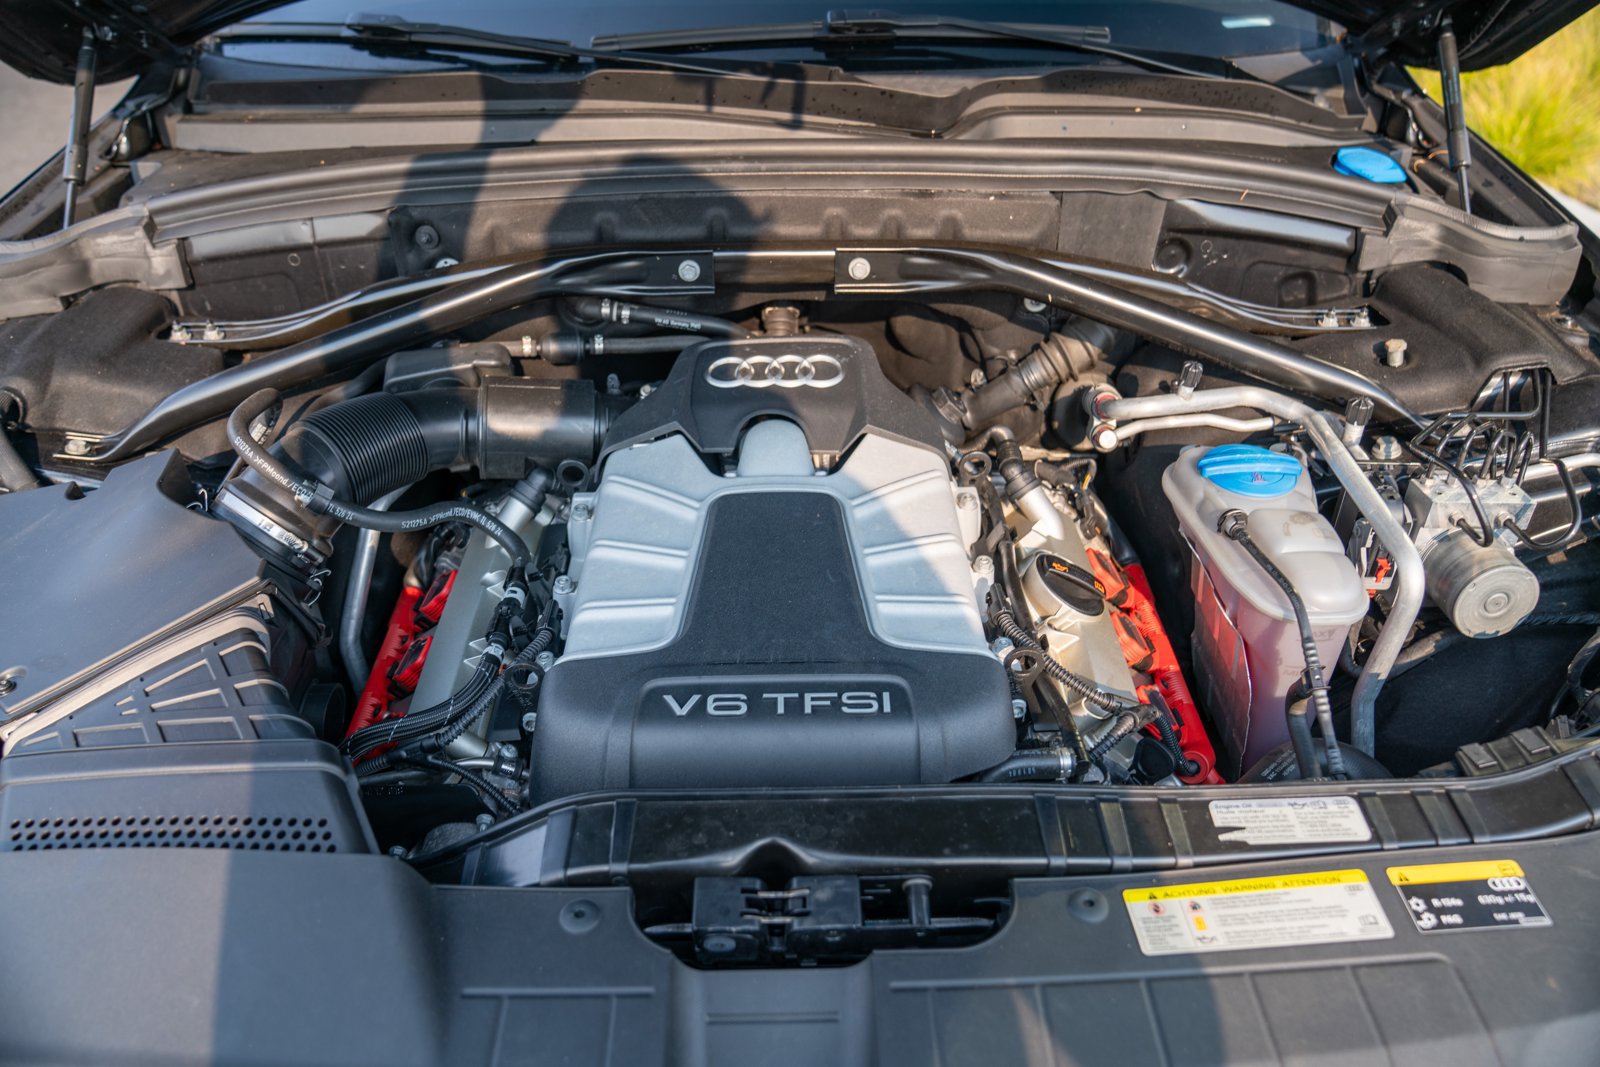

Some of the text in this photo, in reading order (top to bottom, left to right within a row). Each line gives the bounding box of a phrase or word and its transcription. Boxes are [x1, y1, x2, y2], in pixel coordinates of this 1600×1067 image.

[663, 691, 891, 716] V6 TFSI
[1163, 876, 1341, 899] ACHTUNG WARNING ATTENTION
